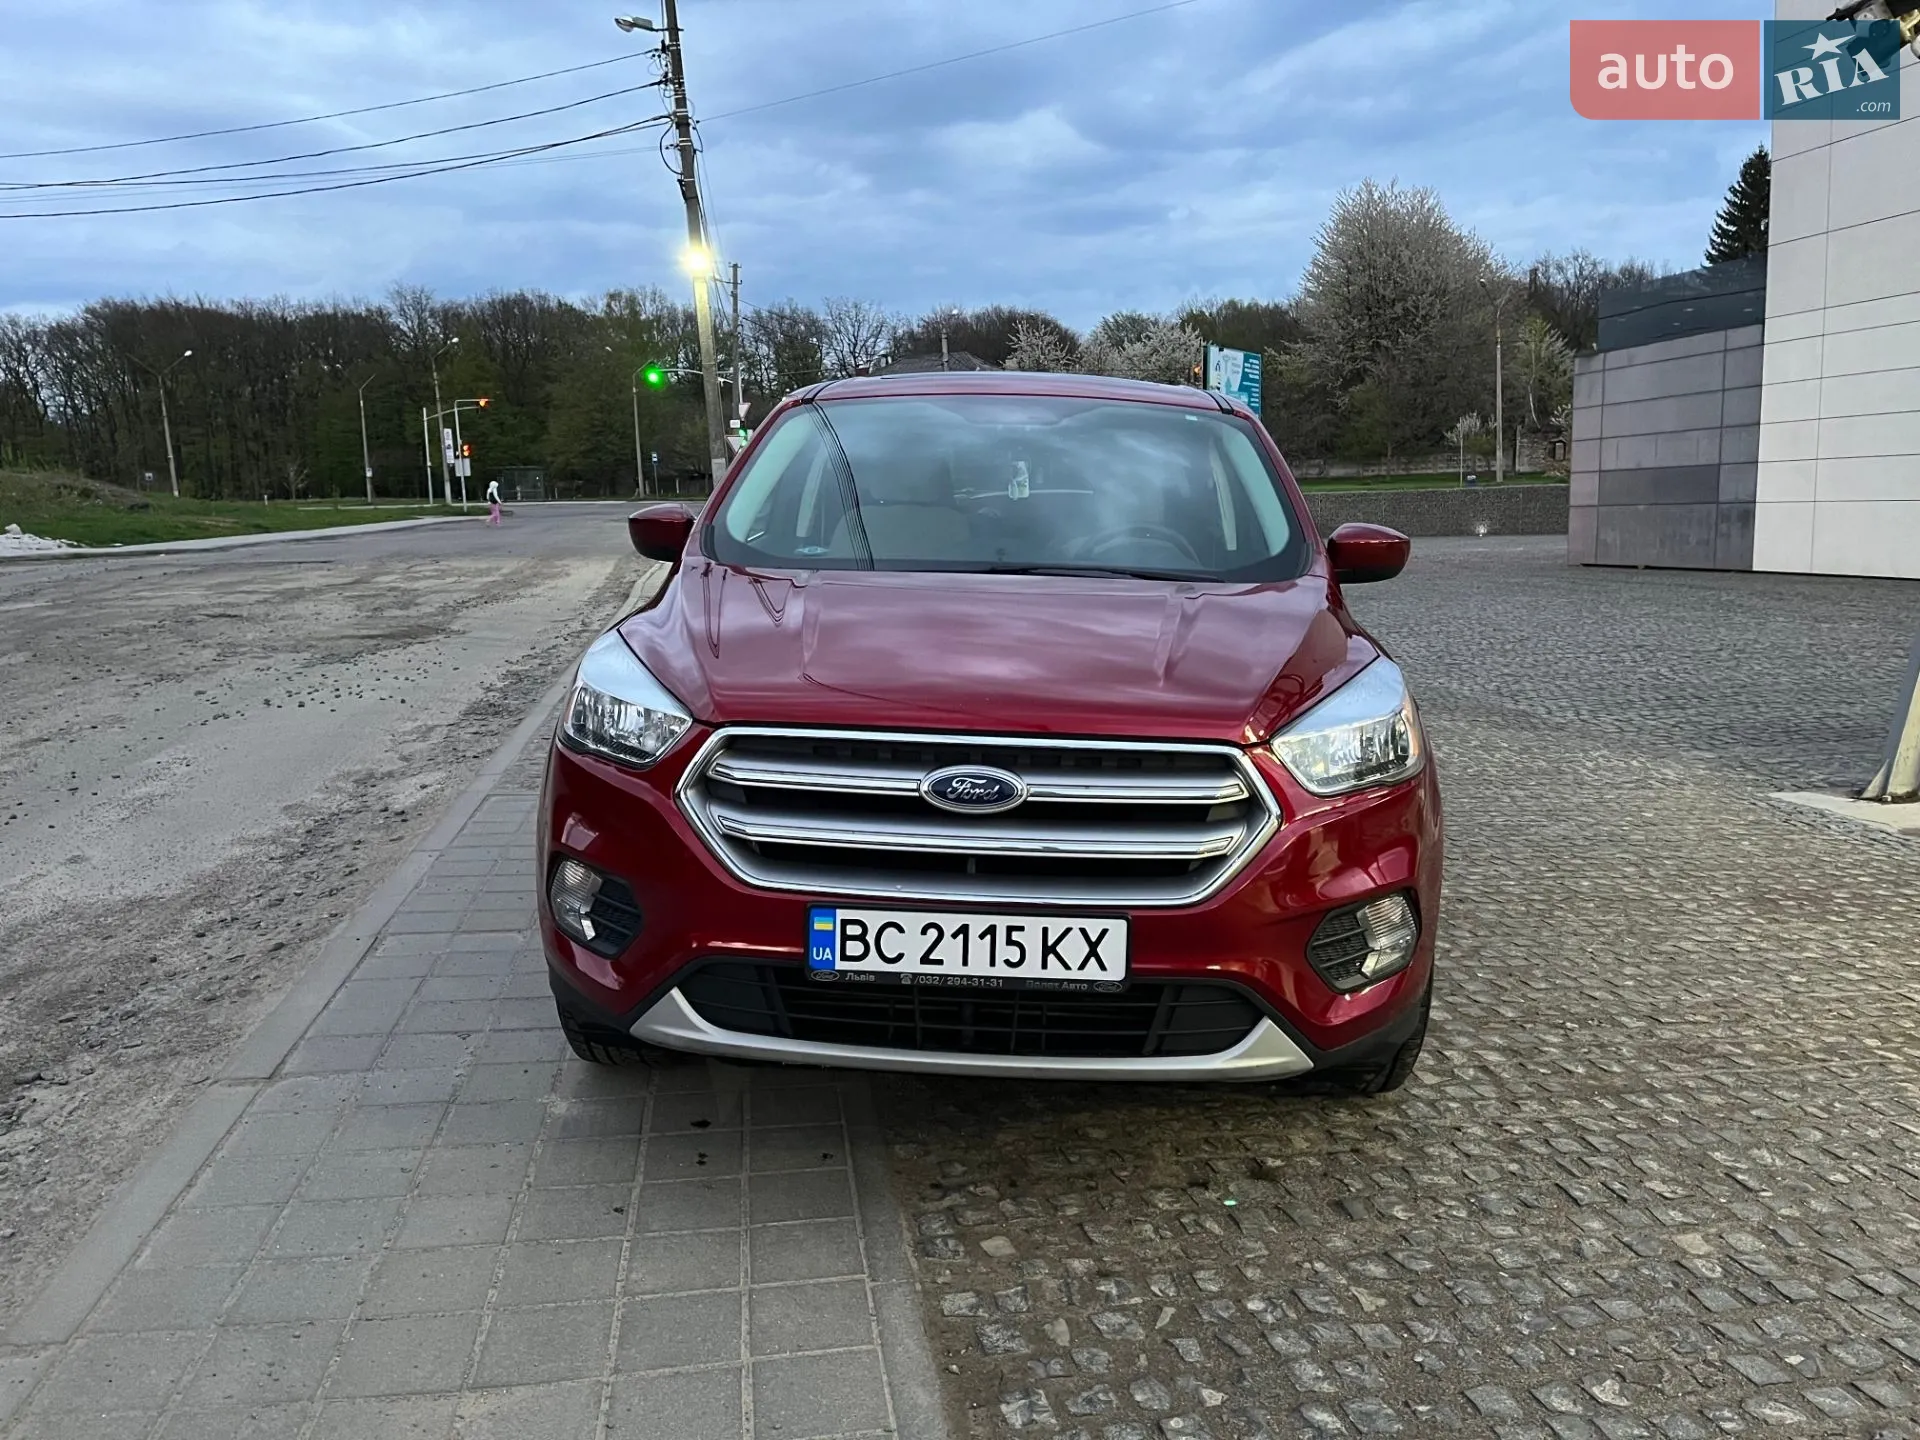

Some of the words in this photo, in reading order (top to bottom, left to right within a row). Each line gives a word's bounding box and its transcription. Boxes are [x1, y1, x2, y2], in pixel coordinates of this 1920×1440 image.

[946, 777, 1000, 800] Ford
[839, 918, 906, 965] BC
[919, 922, 1027, 969] 2115
[1041, 926, 1110, 971] KX
[813, 947, 833, 961] UA
[845, 973, 876, 982] Львів
[947, 977, 1003, 987] 294-31-31
[1061, 981, 1088, 990] Авто
